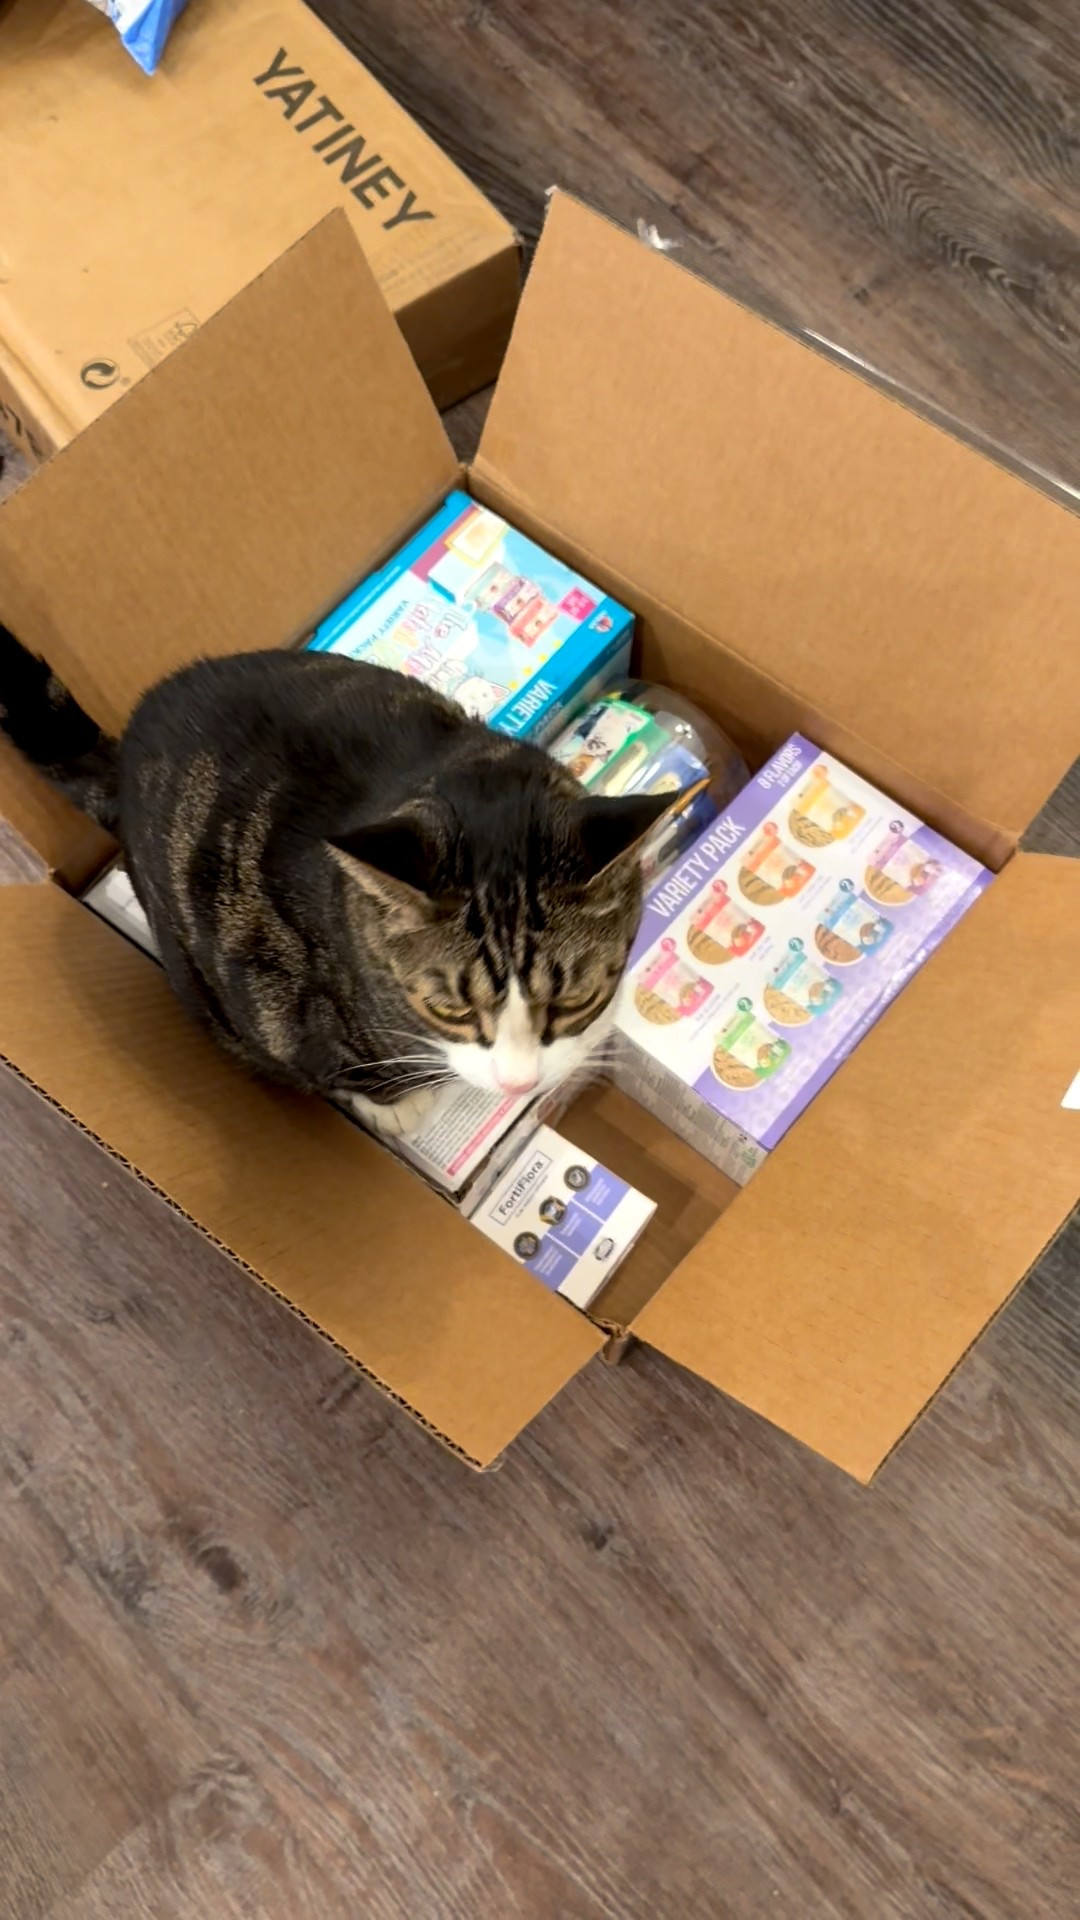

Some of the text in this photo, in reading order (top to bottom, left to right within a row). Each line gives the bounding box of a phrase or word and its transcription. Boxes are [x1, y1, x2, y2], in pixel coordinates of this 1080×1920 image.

[253, 47, 436, 230] YATINEY
[498, 679, 558, 737] VARIETY
[757, 743, 803, 790] 8 FLAVORS
[645, 815, 747, 918] VARIETY PACK
[498, 1161, 544, 1217] FortiFlora
